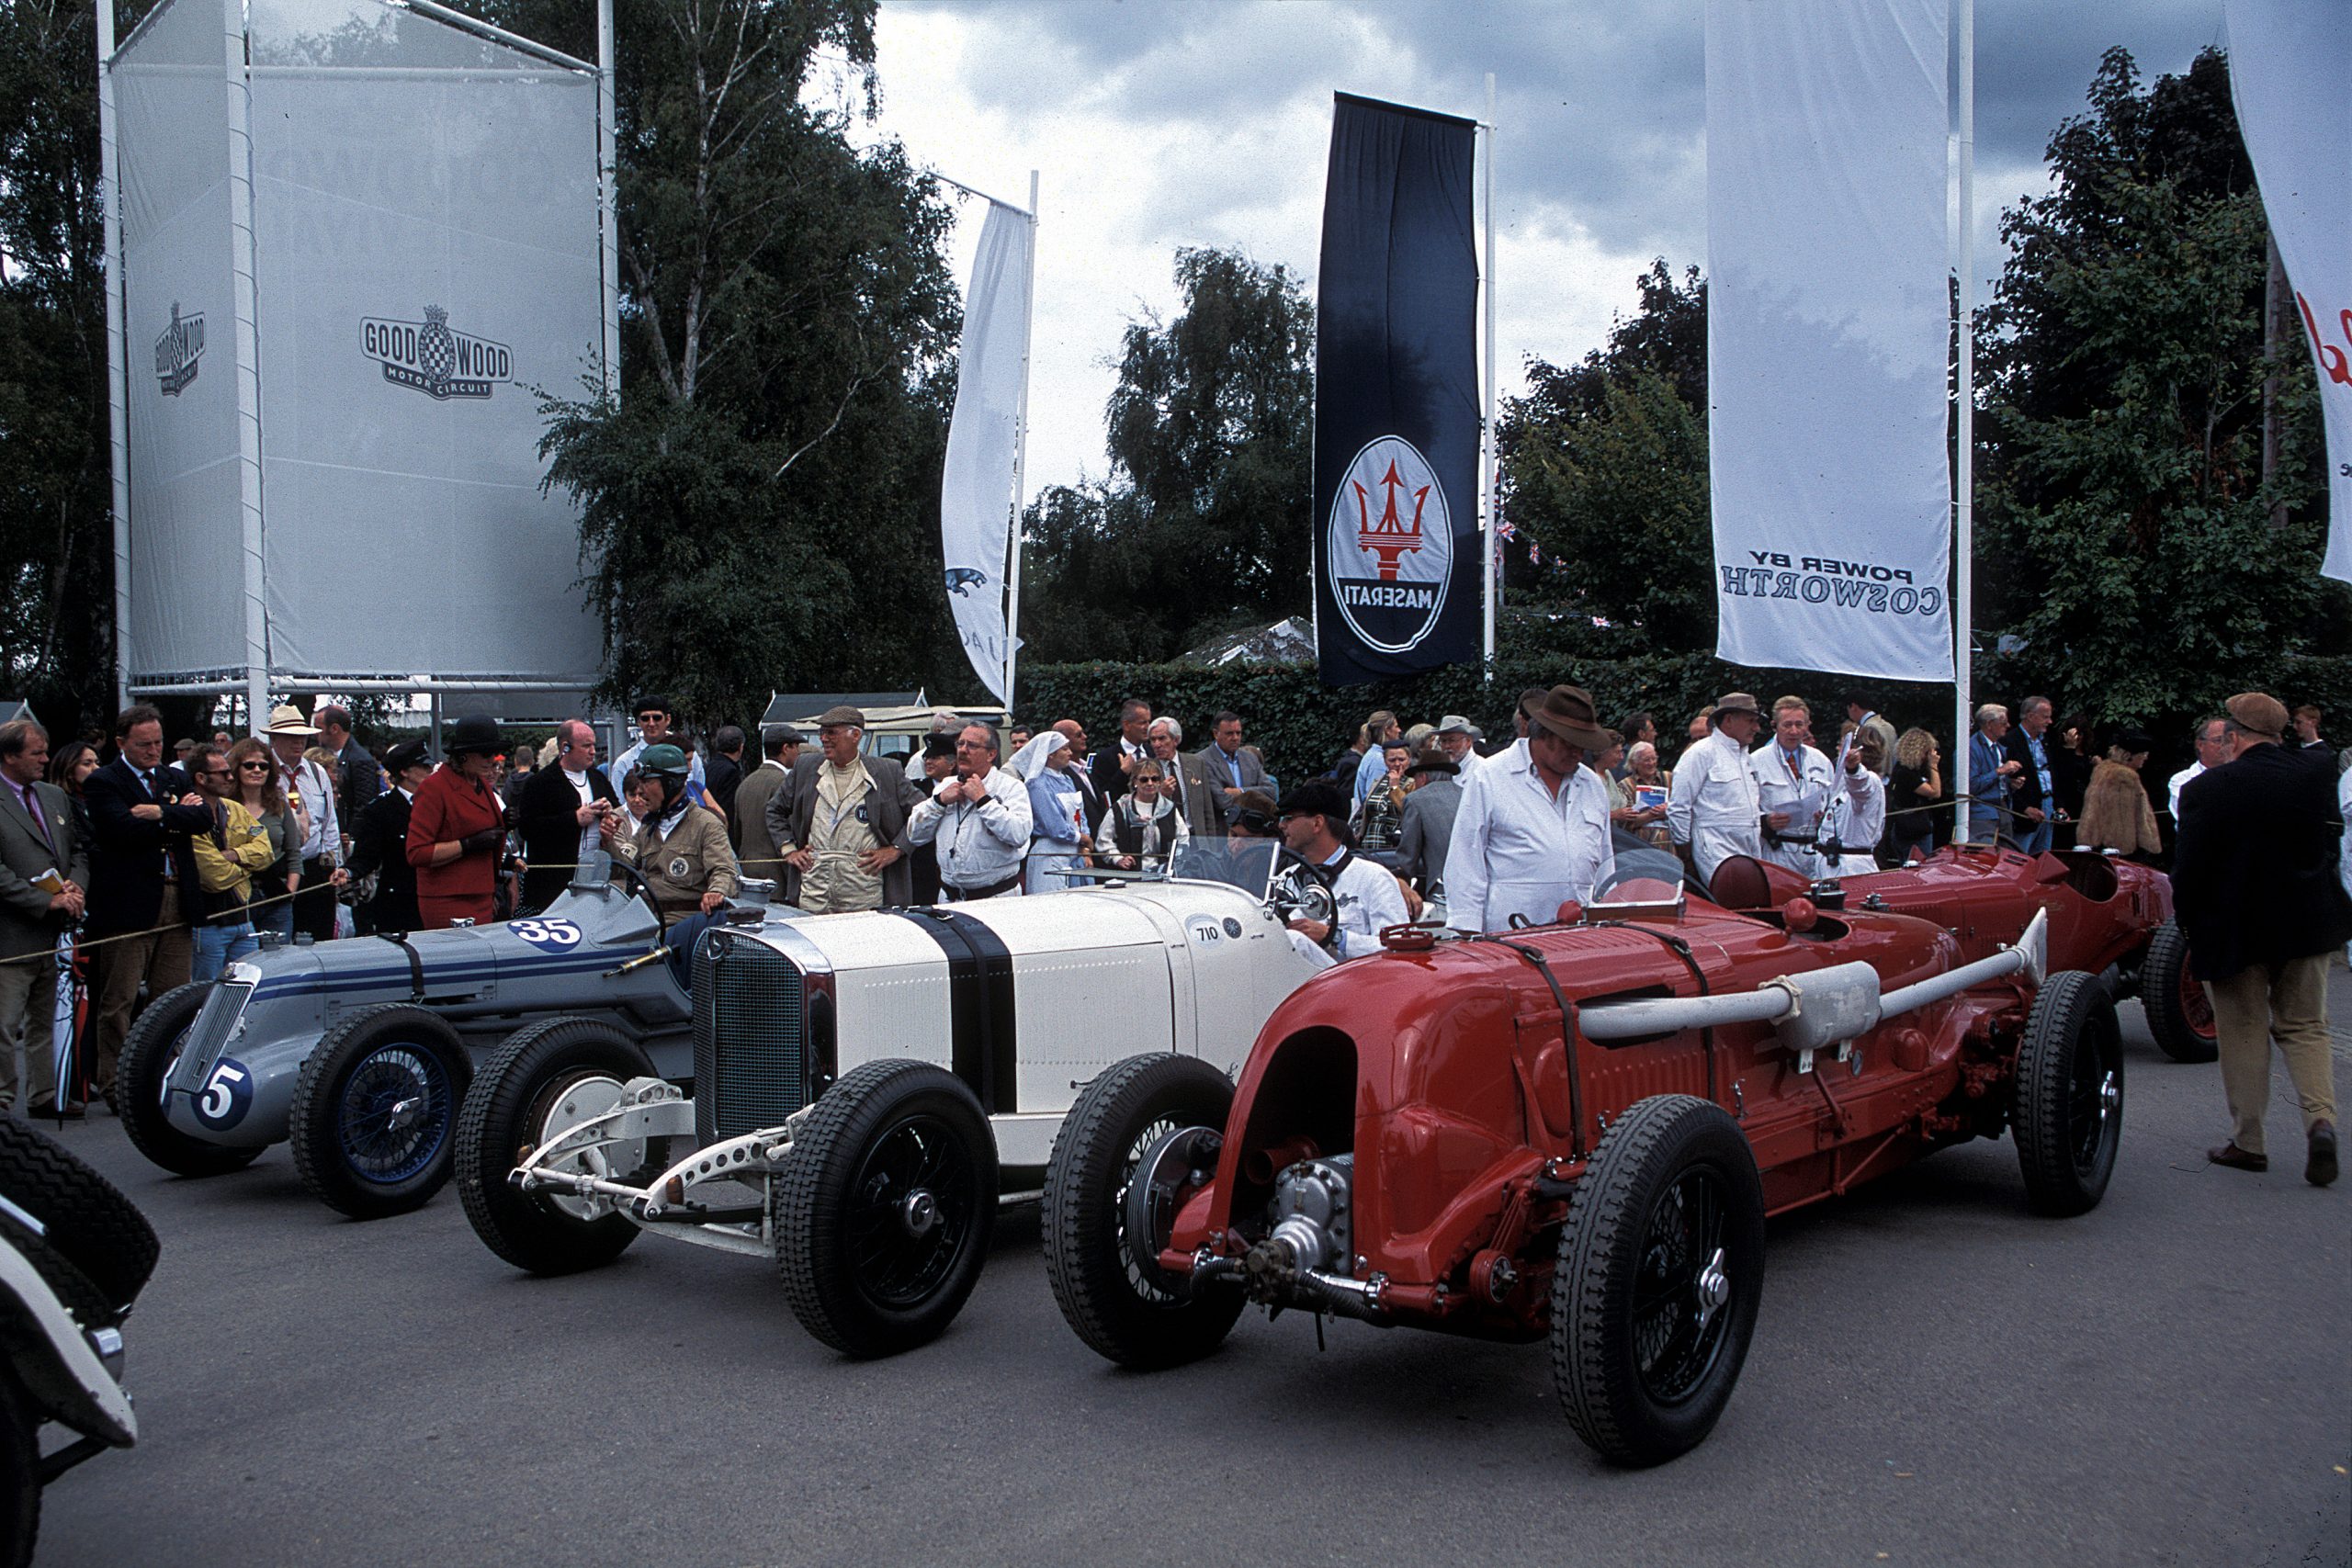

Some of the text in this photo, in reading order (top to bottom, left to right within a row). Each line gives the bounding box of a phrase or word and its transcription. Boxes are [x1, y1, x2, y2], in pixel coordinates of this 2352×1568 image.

[365, 322, 416, 365] GOOD
[456, 336, 509, 378] WOOD
[388, 367, 489, 394] MOTOR CIRCUIT
[510, 919, 581, 944] 35
[1196, 926, 1218, 942] 710
[201, 1064, 245, 1119] 5
